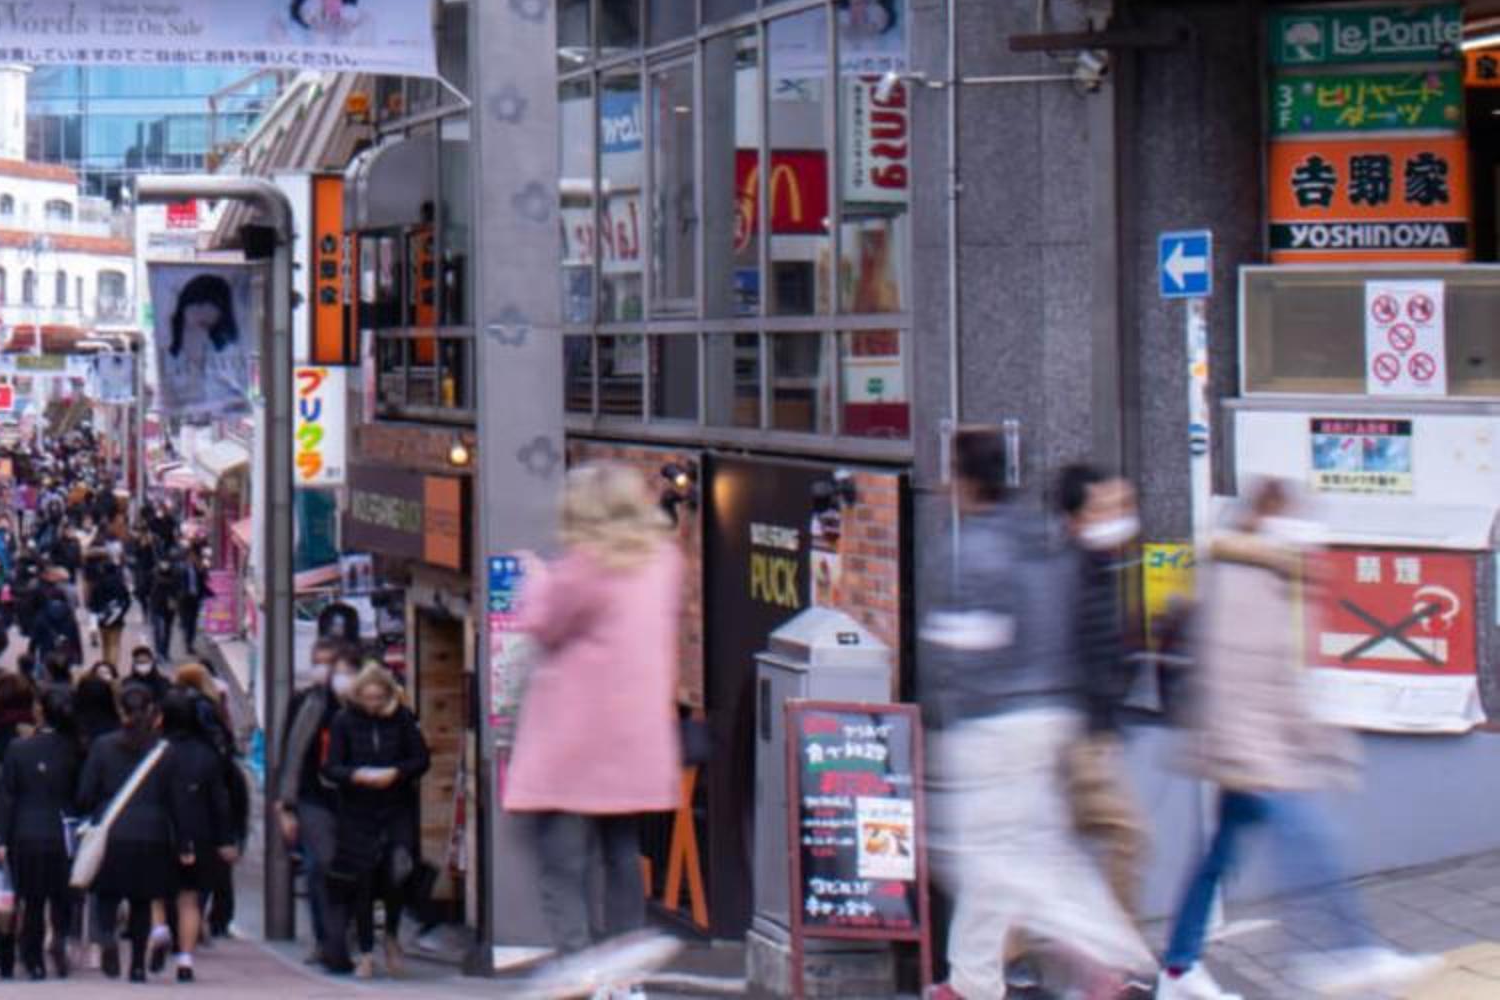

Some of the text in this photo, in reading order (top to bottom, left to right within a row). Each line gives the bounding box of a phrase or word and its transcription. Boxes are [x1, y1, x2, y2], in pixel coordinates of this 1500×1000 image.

[1333, 15, 1464, 54] Le Ponte
[1291, 152, 1451, 208] 吉野家
[1289, 222, 1451, 248] YOSHINOYA
